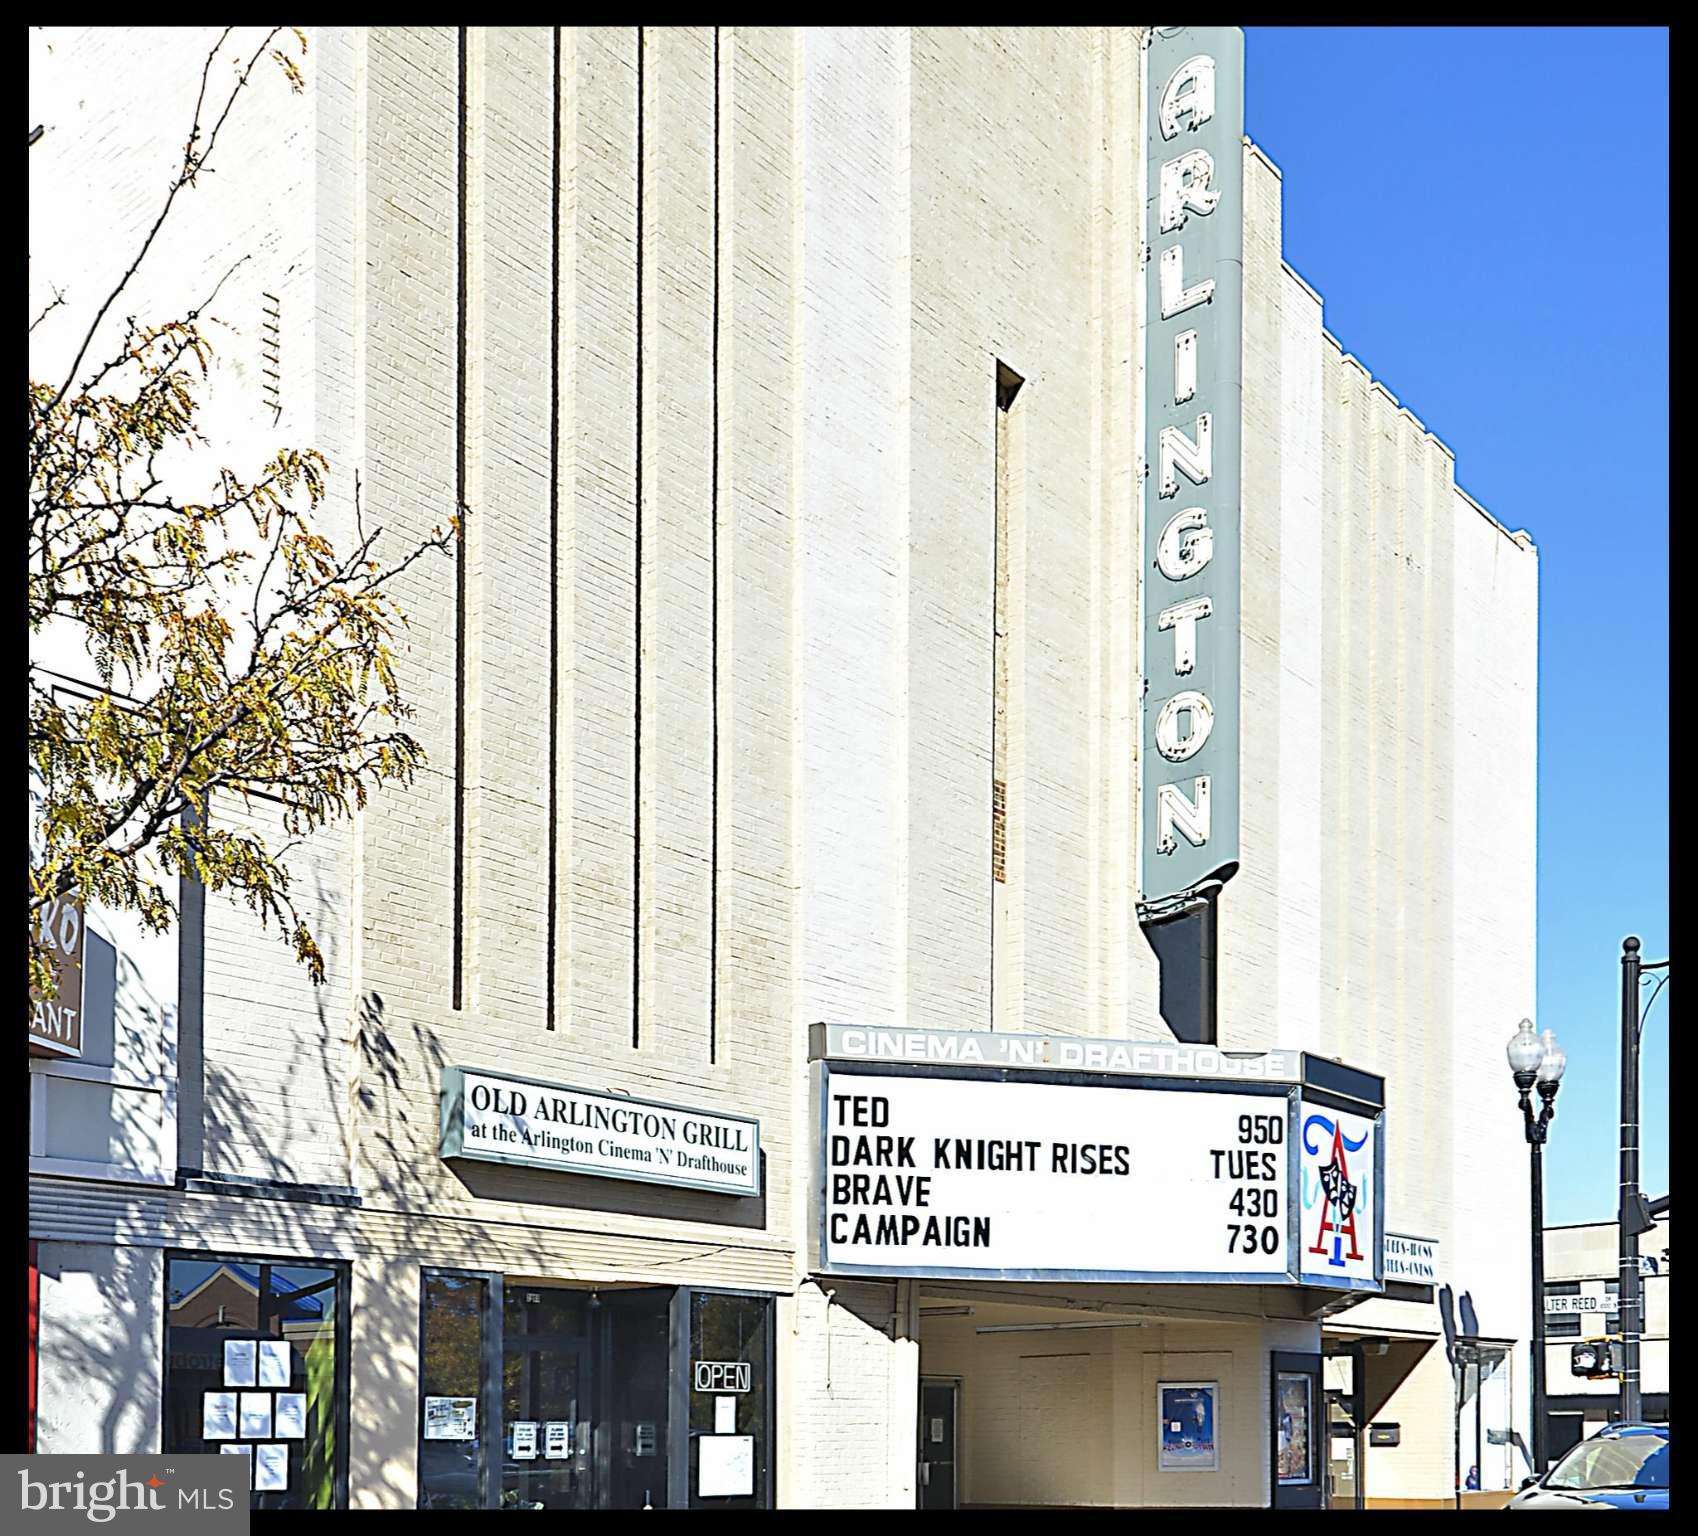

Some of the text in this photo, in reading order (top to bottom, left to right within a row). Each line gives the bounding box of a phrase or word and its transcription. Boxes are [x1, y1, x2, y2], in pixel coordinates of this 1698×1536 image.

[1155, 54, 1222, 856] ARLINGTON
[29, 1001, 78, 1040] ANT
[841, 1030, 984, 1062] CINEMA
[1060, 1043, 1284, 1076] DRAFTHOUSE
[471, 1084, 748, 1152] OLD ARLINGTON GRILL
[833, 1094, 1283, 1144] TED 950
[471, 1123, 748, 1177] at the Arlington Cinema 'N' Drafthouse
[831, 1135, 1276, 1181] DARK KNIGHT RISES TUES
[832, 1174, 1278, 1217] BRAVE 430
[830, 1213, 1279, 1254] CAMPAIGN 730
[1572, 1296, 1597, 1310] REED
[698, 1364, 748, 1390] OPEN
